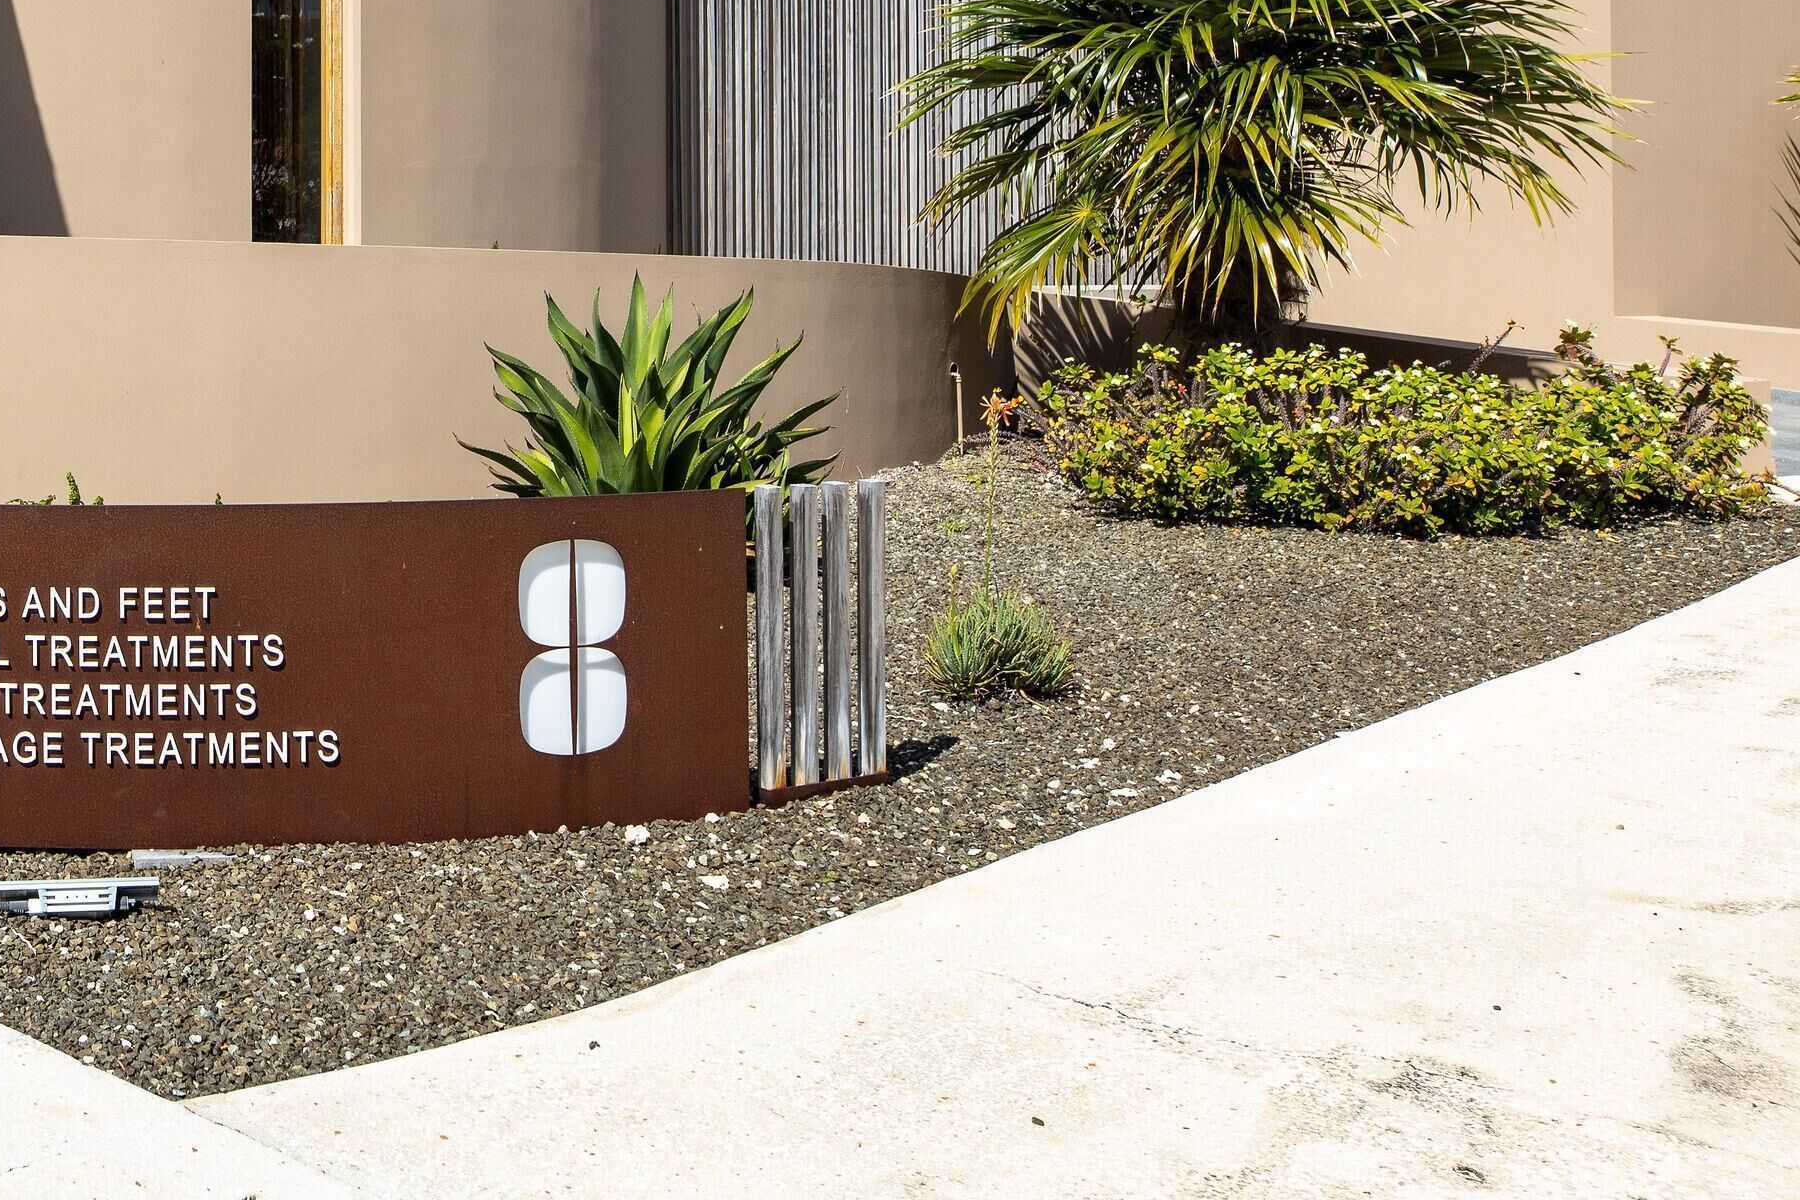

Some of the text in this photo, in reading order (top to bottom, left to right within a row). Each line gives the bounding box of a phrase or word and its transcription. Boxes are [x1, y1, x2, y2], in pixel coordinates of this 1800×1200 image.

[21, 586, 100, 619] AND
[119, 586, 216, 619] FEET
[24, 633, 284, 668] TREATMENTS
[80, 729, 339, 765] TREATMENTS
